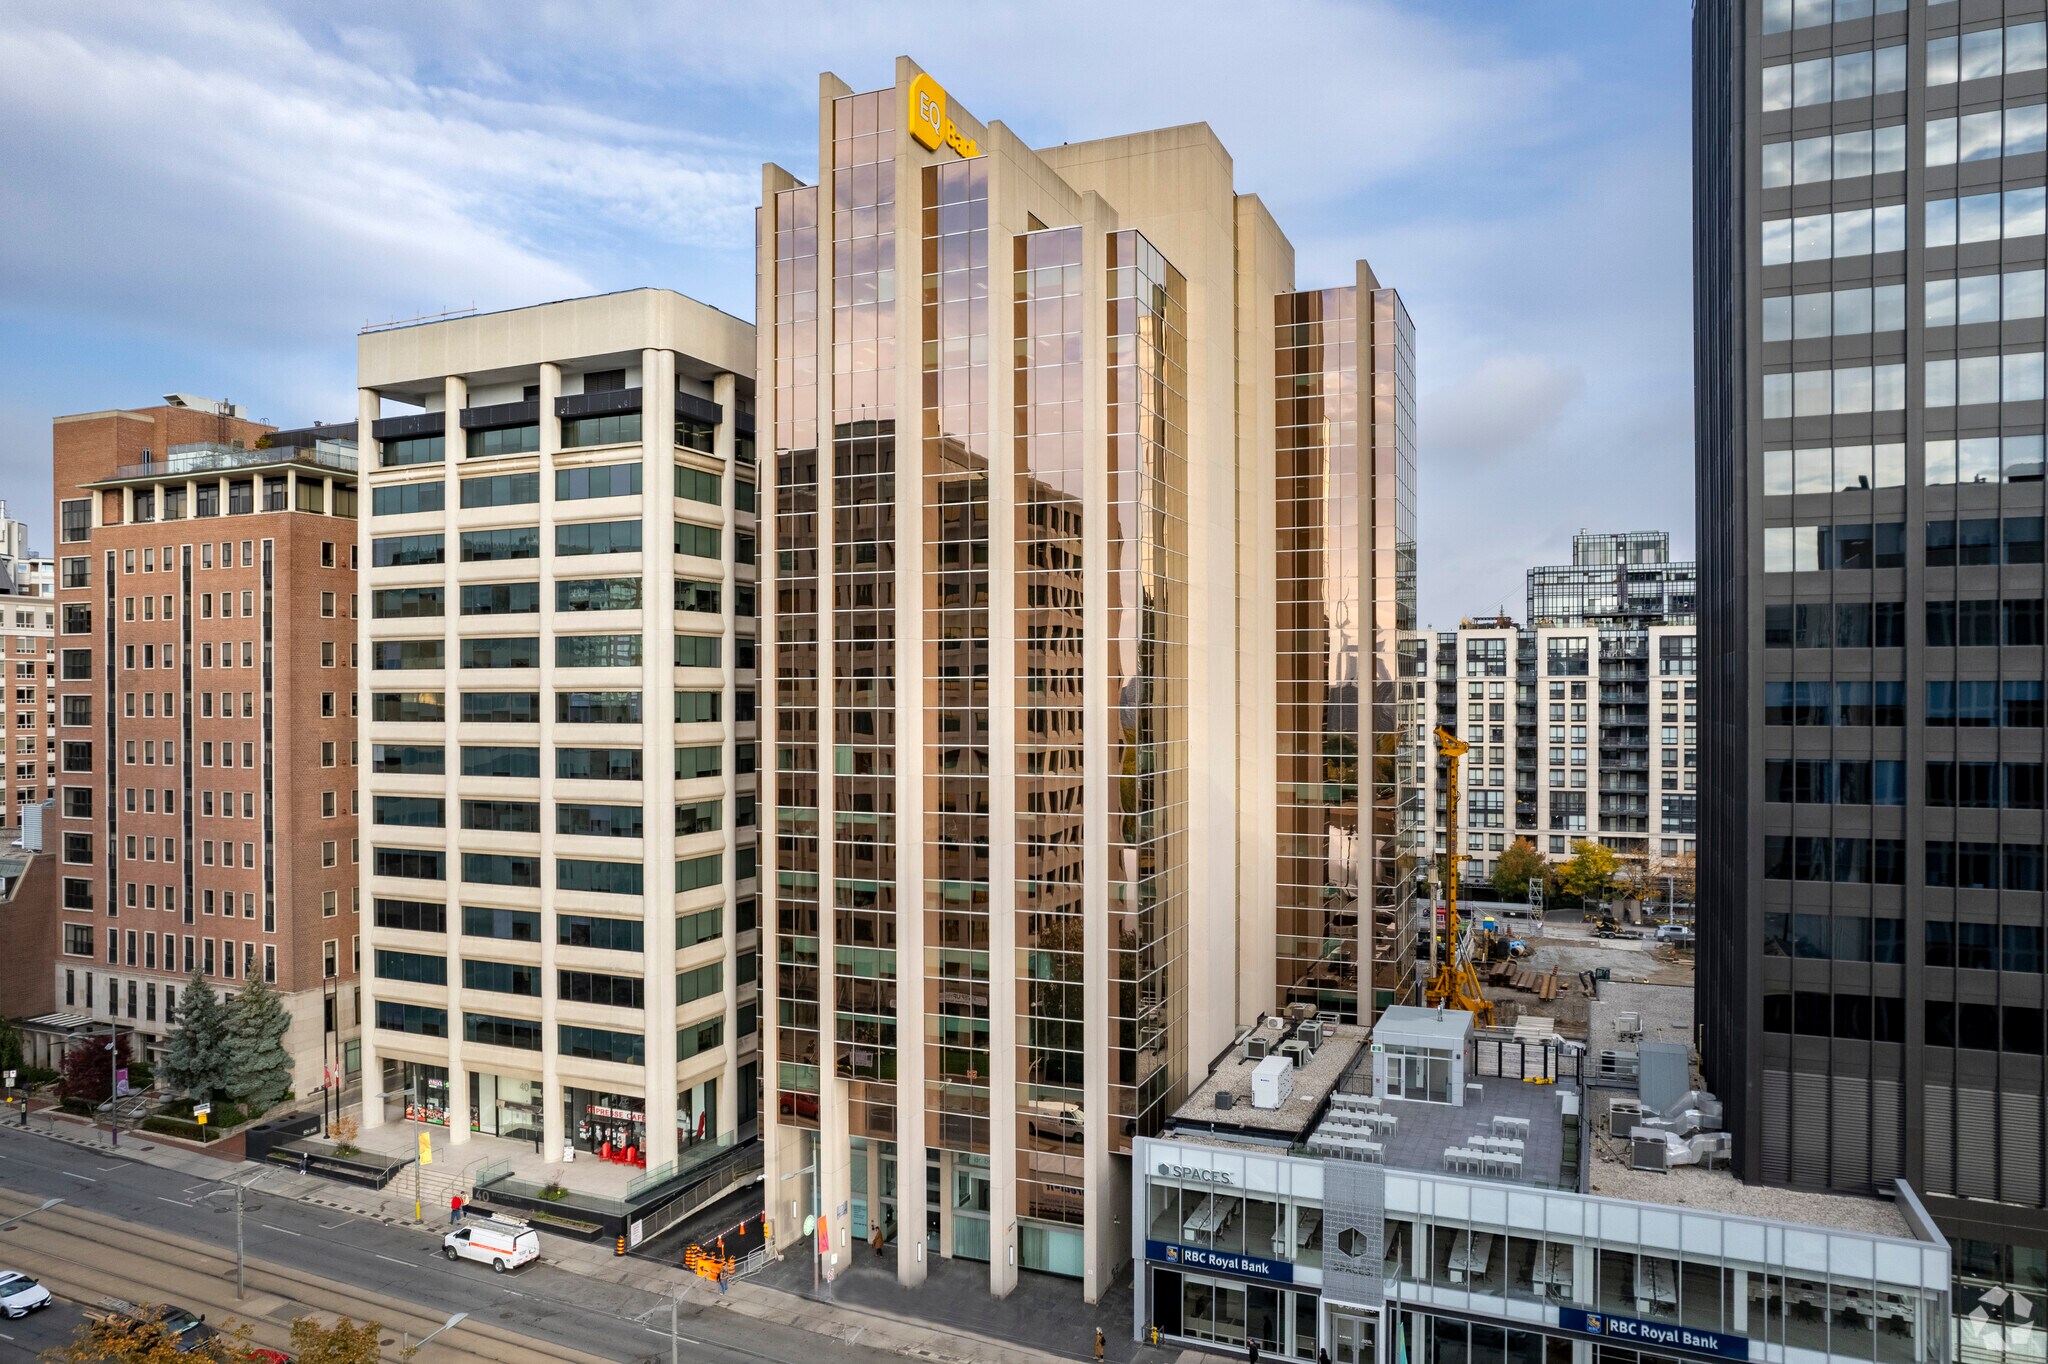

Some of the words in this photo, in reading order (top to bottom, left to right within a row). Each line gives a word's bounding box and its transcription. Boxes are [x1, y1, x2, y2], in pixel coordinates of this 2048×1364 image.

[919, 90, 941, 137] EQ
[520, 1082, 530, 1092] 40
[475, 1190, 490, 1202] 40
[1184, 1250, 1207, 1264] RBC
[1208, 1254, 1239, 1270] Royal
[1241, 1259, 1270, 1275] Bank
[1609, 1319, 1638, 1336] RBC
[1640, 1324, 1680, 1343] Royal
[1682, 1331, 1719, 1350] Bank
